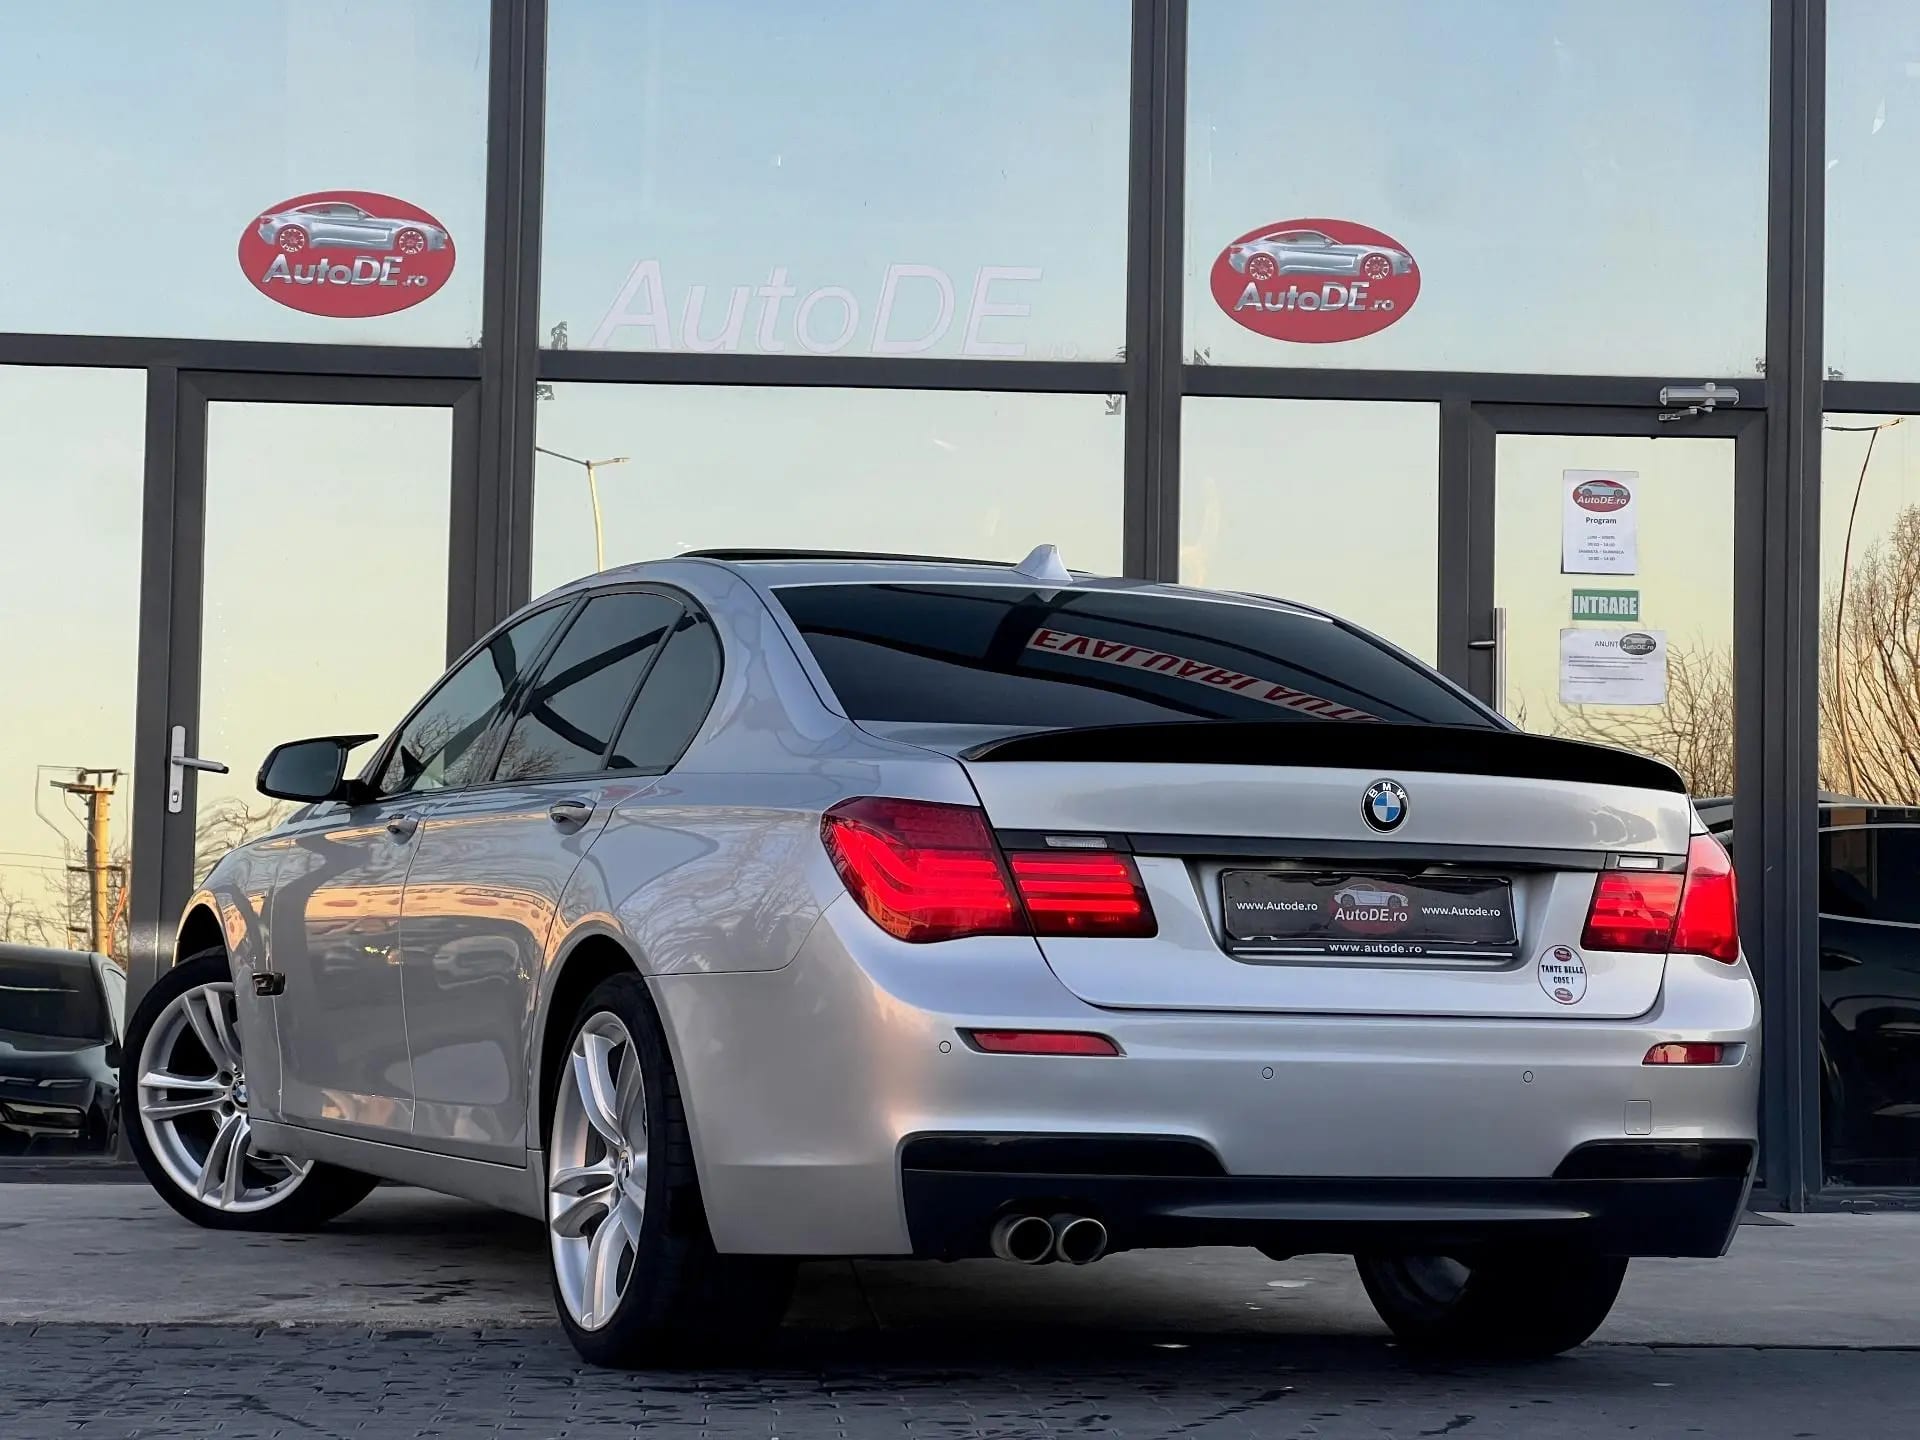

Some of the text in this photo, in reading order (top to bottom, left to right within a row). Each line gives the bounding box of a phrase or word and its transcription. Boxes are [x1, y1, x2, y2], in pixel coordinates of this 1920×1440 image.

[1577, 495, 1627, 505] AutoDE.ro
[1585, 517, 1617, 525] Program
[1573, 595, 1637, 614] INTRARE
[1368, 782, 1406, 800] BMW
[1236, 901, 1318, 912] www.Autode.ro
[1421, 906, 1501, 917] www.Autode.ro
[1334, 907, 1408, 922] AutoDE.ro
[1329, 942, 1422, 953] www.autode.ro
[1541, 965, 1584, 974] TANTE BELLE
[1553, 976, 1570, 984] COSE
